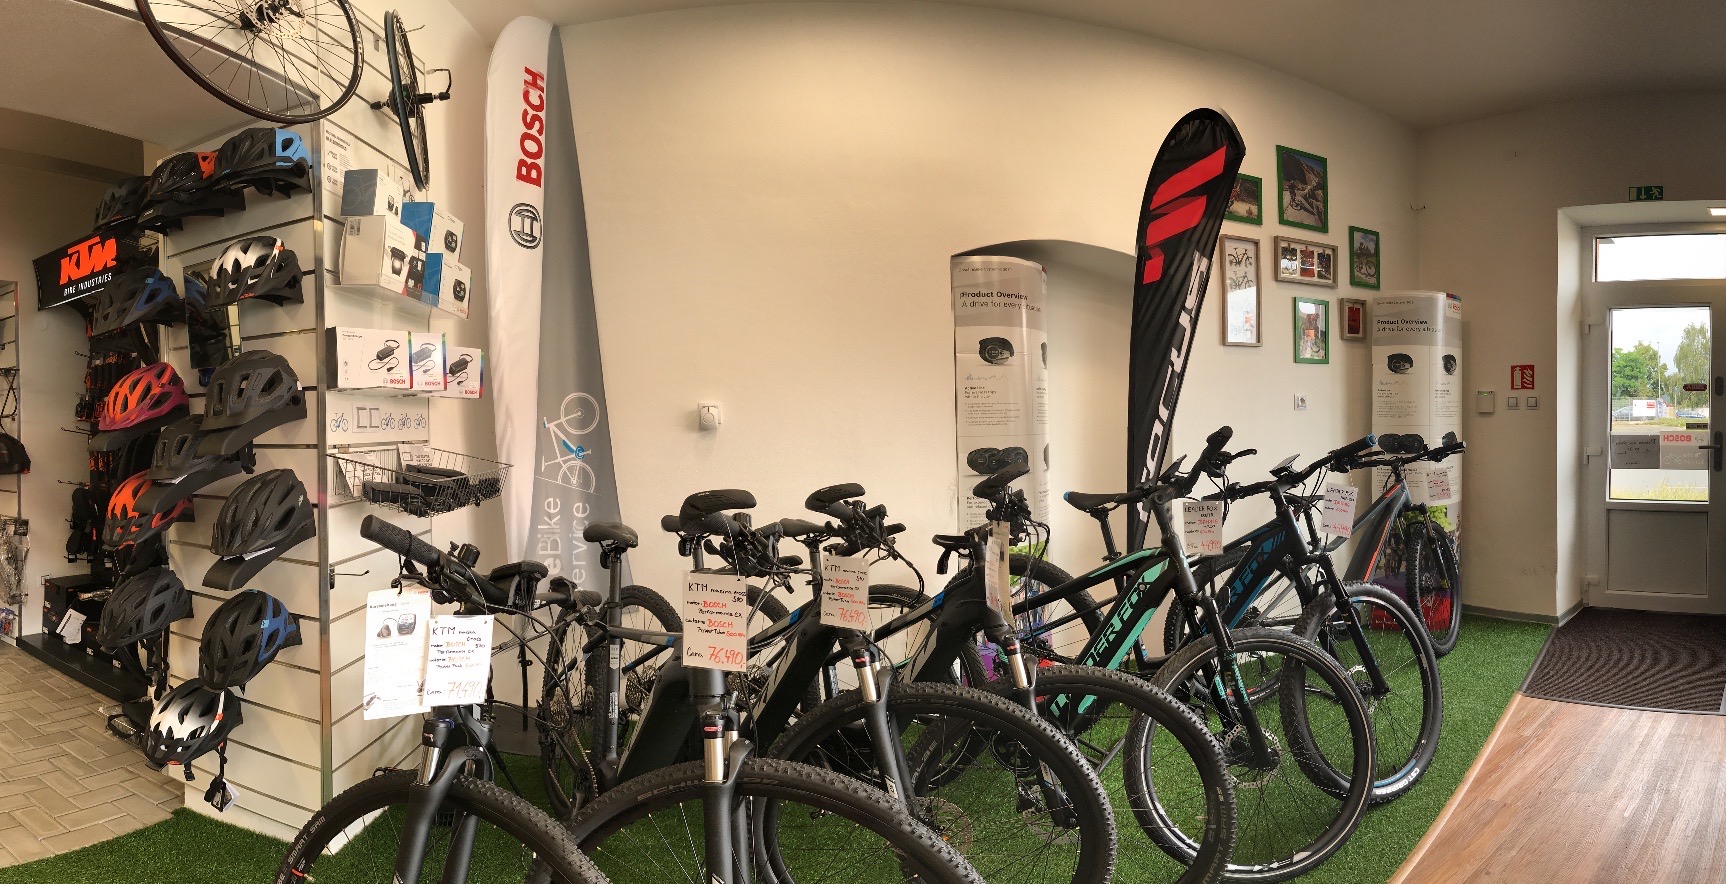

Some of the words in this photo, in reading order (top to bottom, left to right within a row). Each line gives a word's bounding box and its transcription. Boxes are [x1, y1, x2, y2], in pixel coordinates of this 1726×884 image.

[516, 66, 545, 188] BOSCH
[60, 236, 117, 285] KTM
[960, 291, 993, 299] Product
[570, 502, 590, 592] ervice
[824, 564, 841, 572] KTM
[688, 582, 708, 592] KTM
[703, 600, 727, 609] BOSCH
[707, 618, 734, 628] BOSCH
[432, 626, 456, 636] KTM
[287, 833, 309, 865] SMART
[309, 815, 327, 834] SAM
